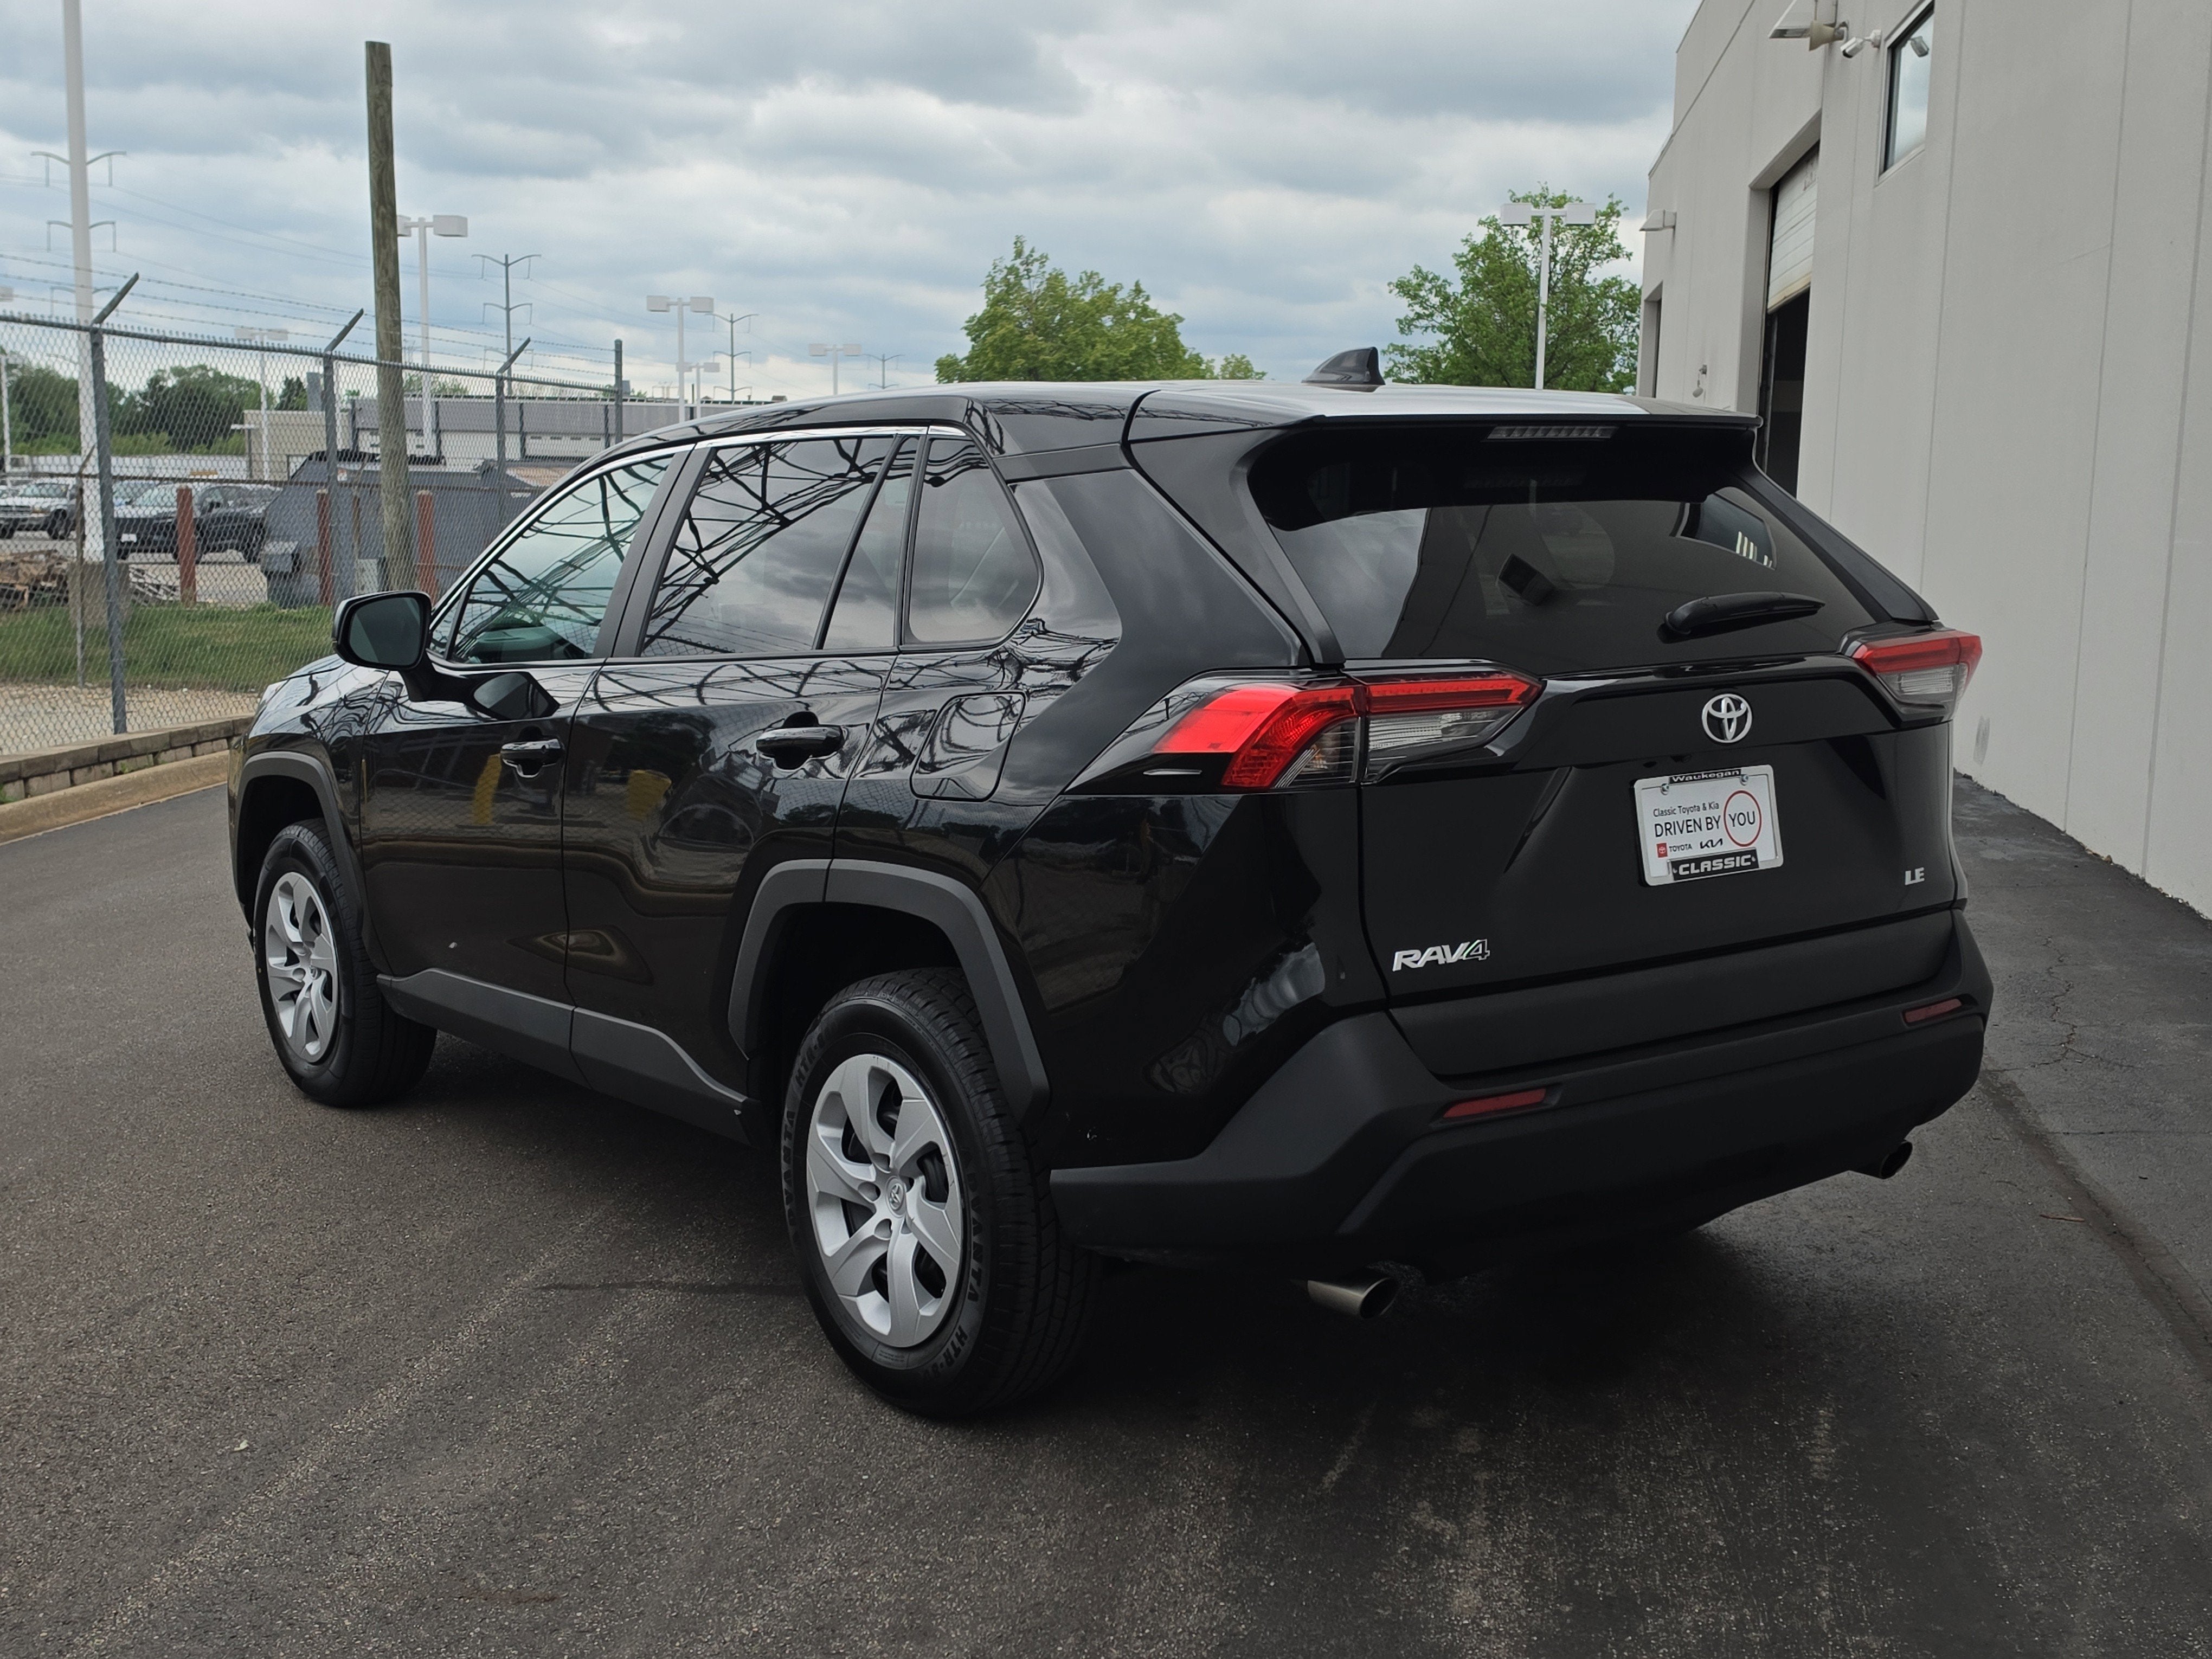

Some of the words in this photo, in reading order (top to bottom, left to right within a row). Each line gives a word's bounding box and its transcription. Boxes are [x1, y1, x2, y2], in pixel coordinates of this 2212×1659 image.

[1672, 769, 1740, 782] Waukegan
[1653, 807, 1676, 817] Classic
[1677, 805, 1700, 815] Toyota
[1702, 802, 1707, 811] &
[1708, 801, 1719, 811] Kia
[1655, 817, 1702, 838] DRIVEN
[1705, 815, 1721, 831] BY
[1728, 811, 1756, 827] YOU
[1669, 844, 1692, 853] TOYOTA
[1679, 854, 1752, 876] CLASSIC
[1905, 867, 1925, 885] LE
[1392, 938, 1490, 972] RAV4
